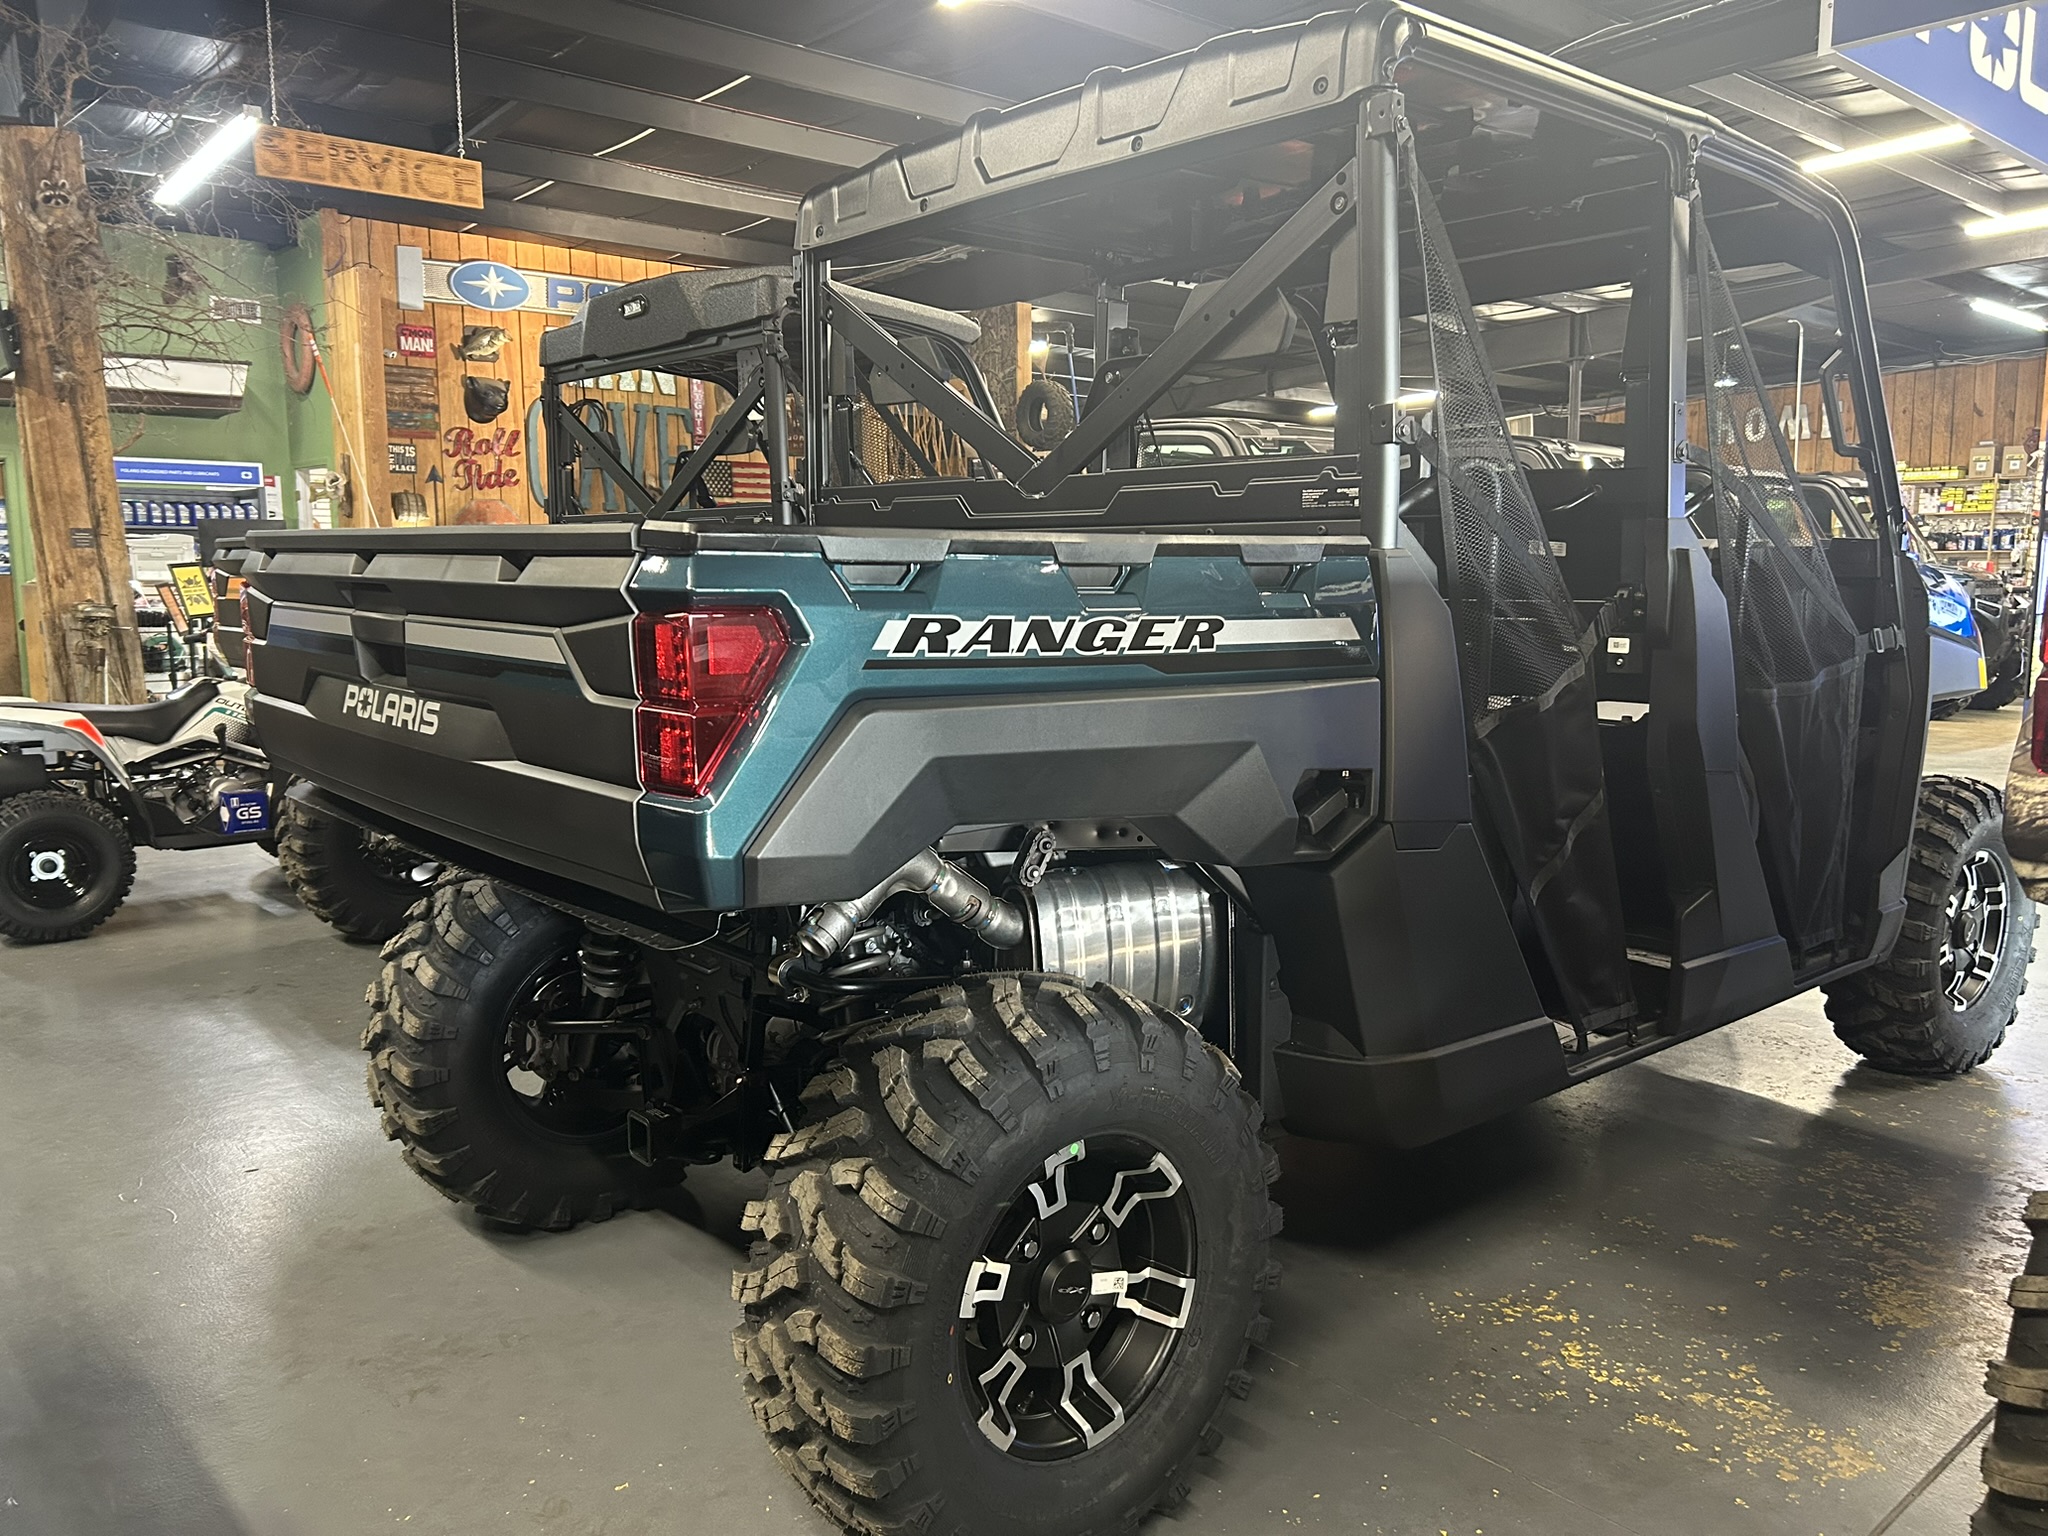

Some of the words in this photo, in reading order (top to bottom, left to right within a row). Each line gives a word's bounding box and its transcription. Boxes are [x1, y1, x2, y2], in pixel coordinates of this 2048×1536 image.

[1915, 7, 2048, 115] OL
[260, 126, 478, 207] SERVICE
[400, 336, 434, 353] MAN!
[388, 445, 404, 453] THIS
[405, 446, 416, 457] IS
[443, 426, 521, 458] Roll
[454, 458, 520, 491] Tide
[886, 614, 1226, 658] RANGER
[342, 684, 441, 736] POLARIS
[236, 805, 262, 820] GS
